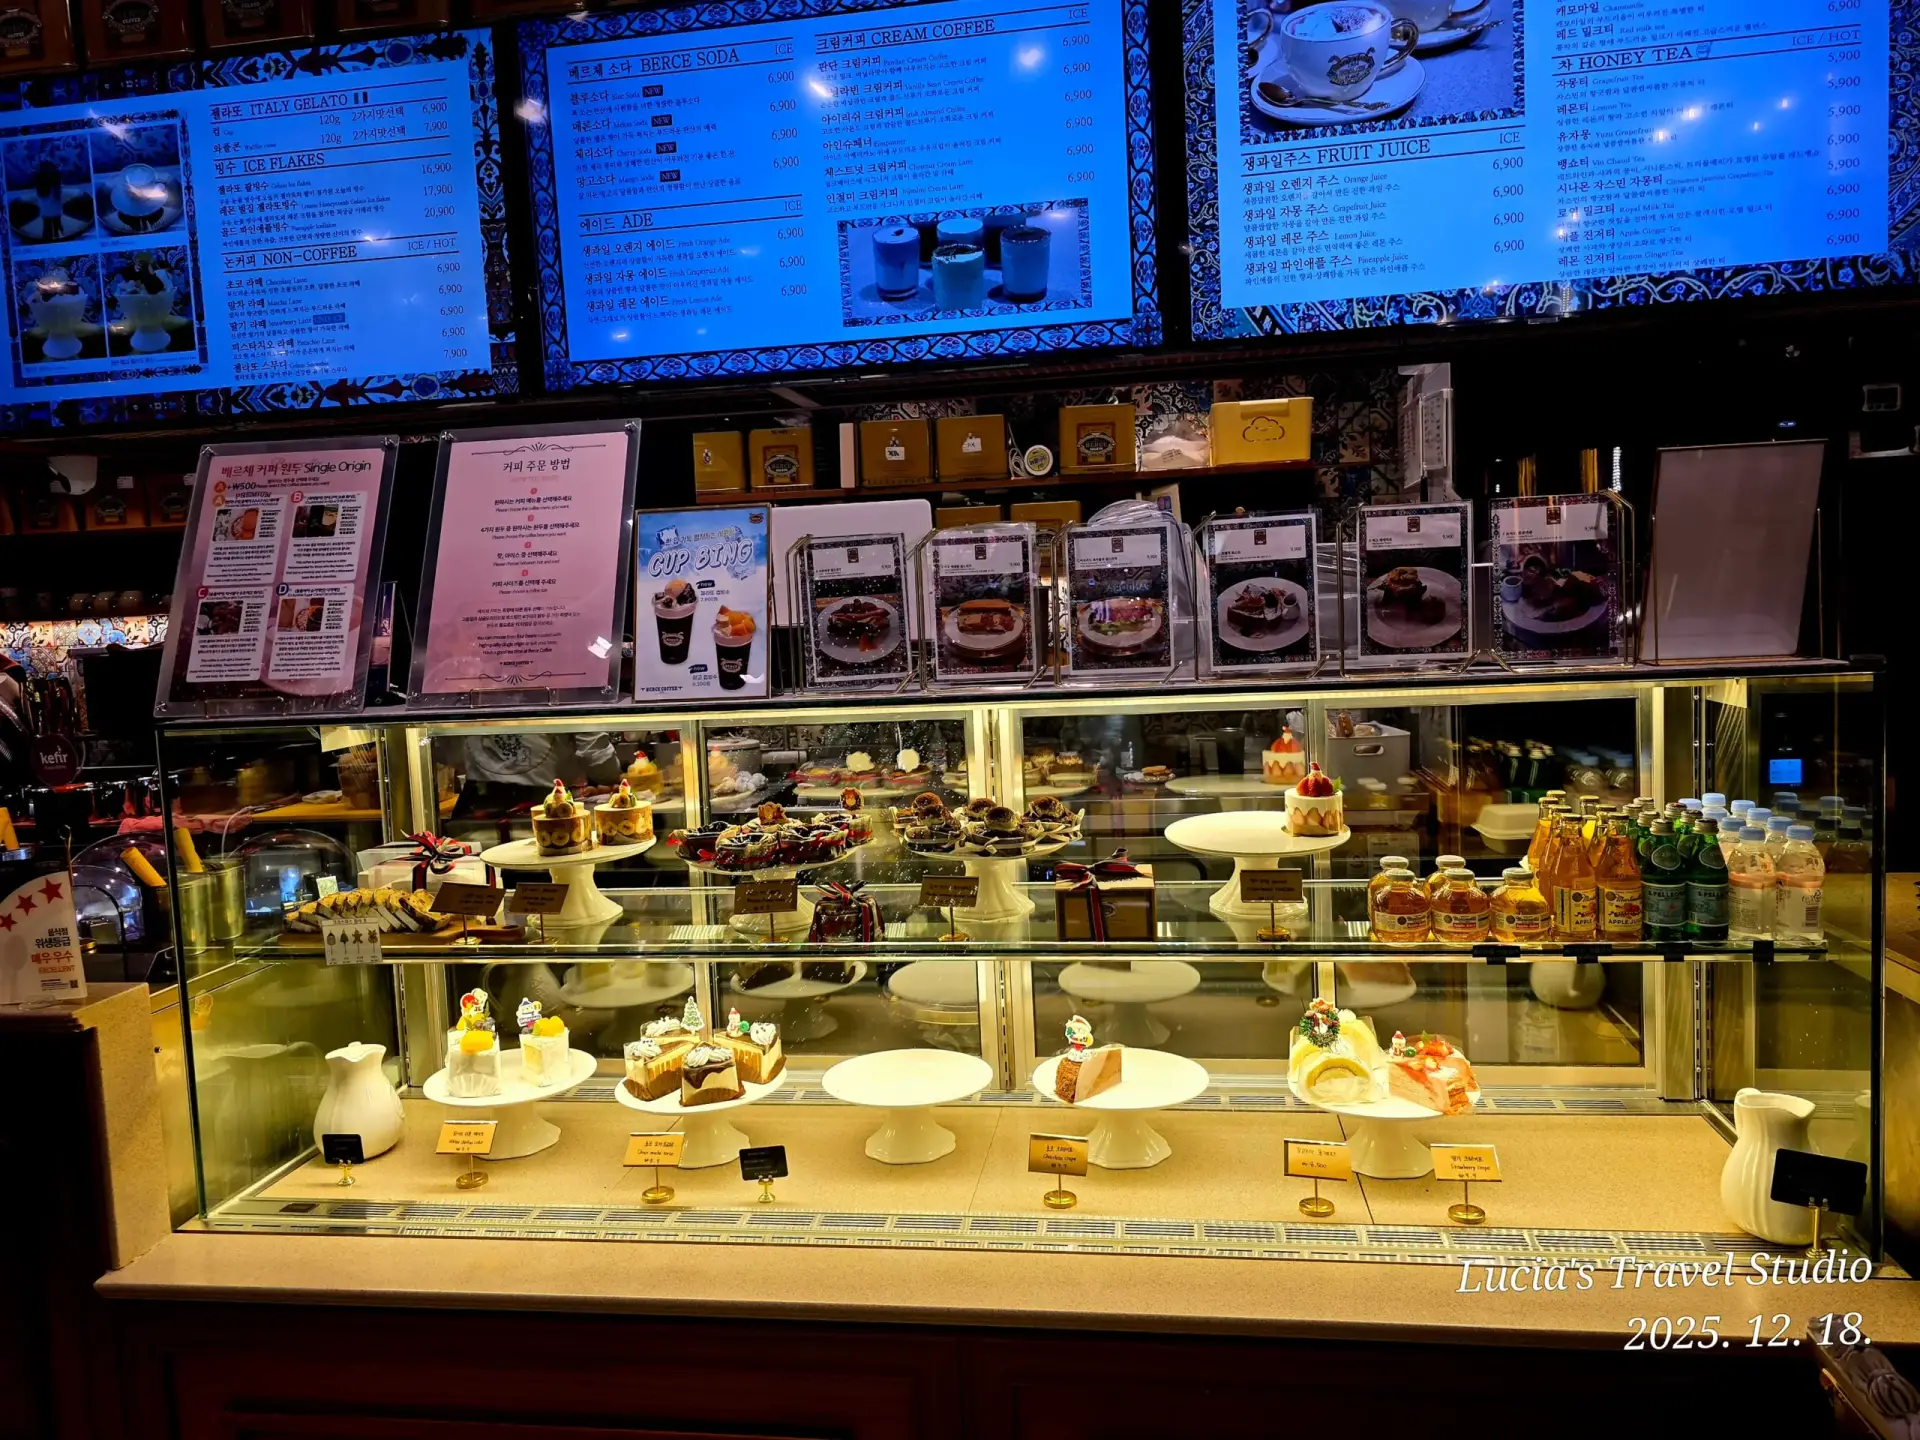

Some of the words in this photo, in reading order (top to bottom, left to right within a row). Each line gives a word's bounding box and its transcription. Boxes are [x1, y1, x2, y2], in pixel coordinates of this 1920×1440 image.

[1068, 10, 1088, 20] ICE
[816, 31, 866, 51] 크림커피
[871, 25, 929, 46] CREAM
[932, 18, 996, 39] COFFEE
[1556, 28, 1578, 40] 레드
[1582, 23, 1614, 38] 밀크티
[1791, 35, 1815, 47] ICE
[1828, 30, 1861, 43] HOT
[1062, 33, 1090, 47] 6,900
[775, 43, 793, 55] ICE
[1827, 49, 1861, 63] 5,900
[569, 62, 603, 79] 베르체
[608, 59, 632, 76] 소다
[641, 53, 692, 72] BERCE
[696, 48, 740, 66] SODA
[841, 55, 881, 69] 크림커피
[1557, 59, 1573, 72] 차
[1578, 50, 1647, 71] HONEY
[1651, 46, 1693, 61] TEA
[1063, 61, 1091, 75] 6,900
[768, 71, 795, 84] 6,900
[1556, 76, 1589, 89] 자몽티
[1828, 75, 1861, 89] 5,900
[644, 86, 662, 96] NEW
[863, 80, 903, 94] 크림커피
[1064, 89, 1092, 102] 6,900
[210, 106, 242, 119] 젤라또
[250, 99, 289, 117] ITALY
[294, 94, 348, 111] GELATO
[422, 102, 447, 115] 6,900
[770, 100, 796, 112] 6,900
[1556, 102, 1589, 116] 레몬티
[1827, 104, 1861, 117] 5,900
[319, 115, 341, 126] 120g
[352, 106, 404, 123] 2가지맛선택
[653, 116, 671, 125] NEW
[865, 107, 905, 121] 크림커피
[424, 120, 448, 133] 7,900
[1065, 116, 1093, 130] 6,900
[320, 133, 342, 145] 120g
[352, 125, 406, 141] 2가지맛선택
[771, 128, 798, 140] 6,900
[1499, 131, 1521, 145] ICE
[1557, 129, 1592, 142] 유자몽
[1827, 132, 1860, 146] 6,900
[657, 143, 675, 152] NEW
[1066, 143, 1094, 157] 6,900
[773, 156, 800, 169] 6,900
[1243, 152, 1312, 172] 생과일주스
[1317, 145, 1373, 165] FRUIT
[1378, 139, 1431, 160] JUICE
[215, 161, 236, 176] 빙수
[243, 157, 266, 173] ICE
[270, 153, 325, 170] FLAKES
[421, 163, 452, 176] 16,900
[867, 159, 908, 174] 크림커피
[1492, 156, 1524, 171] 6,900
[1827, 158, 1861, 170] 5,900
[661, 171, 679, 181] NEW
[1067, 170, 1095, 184] 6,900
[423, 184, 453, 197] 17,900
[1242, 181, 1276, 195] 생과일
[1280, 177, 1313, 191] 오렌지
[1315, 174, 1340, 188] 주스
[1493, 184, 1524, 198] 6,900
[1557, 181, 1590, 194] 시나몬
[1593, 177, 1627, 191] 자스민
[1629, 174, 1663, 187] 자몽티
[1827, 183, 1860, 196] 6,900
[859, 187, 899, 201] 크림커피
[424, 205, 455, 219] 20,900
[784, 200, 803, 211] ICE
[1583, 202, 1616, 216] 밀크티
[1243, 208, 1277, 223] 생과일
[1279, 206, 1302, 220] 자몽
[1306, 203, 1329, 217] 주스
[1493, 211, 1524, 226] 6,900
[1827, 207, 1860, 221] 6,900
[579, 216, 616, 232] 에이드
[622, 212, 653, 229] ADE
[777, 227, 804, 240] 6,900
[1243, 235, 1277, 249] 생과일
[1280, 233, 1304, 246] 레몬
[1307, 230, 1329, 243] 주스
[1583, 227, 1616, 241] 진저티
[1827, 232, 1860, 246] 6,900
[407, 240, 424, 252] ICE
[432, 237, 456, 250] HOT
[581, 244, 611, 258] 생과일
[613, 241, 643, 254] 오렌지
[645, 238, 676, 251] 에이드
[1493, 239, 1525, 254] 6,900
[223, 255, 256, 269] 논커피
[262, 245, 358, 266] NON-COFFEE
[779, 256, 806, 268] 6,900
[1557, 255, 1580, 268] 레몬
[1583, 251, 1616, 265] 진저티
[437, 262, 461, 273] 6,900
[1244, 261, 1277, 276] 생과일
[1280, 257, 1326, 272] 파인애플
[1329, 254, 1353, 268] 주스
[226, 279, 243, 289] 초코
[246, 277, 264, 288] 라떼
[583, 272, 613, 286] 생과일
[616, 269, 635, 282] 자몽
[638, 267, 668, 281] 에이드
[438, 283, 463, 295] 6,900
[780, 285, 807, 297] 6,900
[440, 305, 464, 317] 6,900
[586, 300, 615, 313] 생과일
[617, 297, 637, 310] 레몬
[640, 295, 670, 309] 에이드
[442, 326, 466, 338] 6,900
[443, 347, 467, 359] 7,900
[221, 464, 254, 478] 베르체
[256, 463, 278, 476] 커피
[281, 463, 302, 475] 원두
[303, 462, 337, 475] Single
[338, 460, 371, 473] Origin
[503, 460, 523, 473] 커피
[526, 459, 546, 472] 주문
[550, 458, 570, 471] 방법
[294, 492, 302, 502] B
[648, 547, 690, 577] CUP
[694, 539, 753, 571] BING
[278, 584, 287, 595] D
[39, 751, 68, 765] kefir
